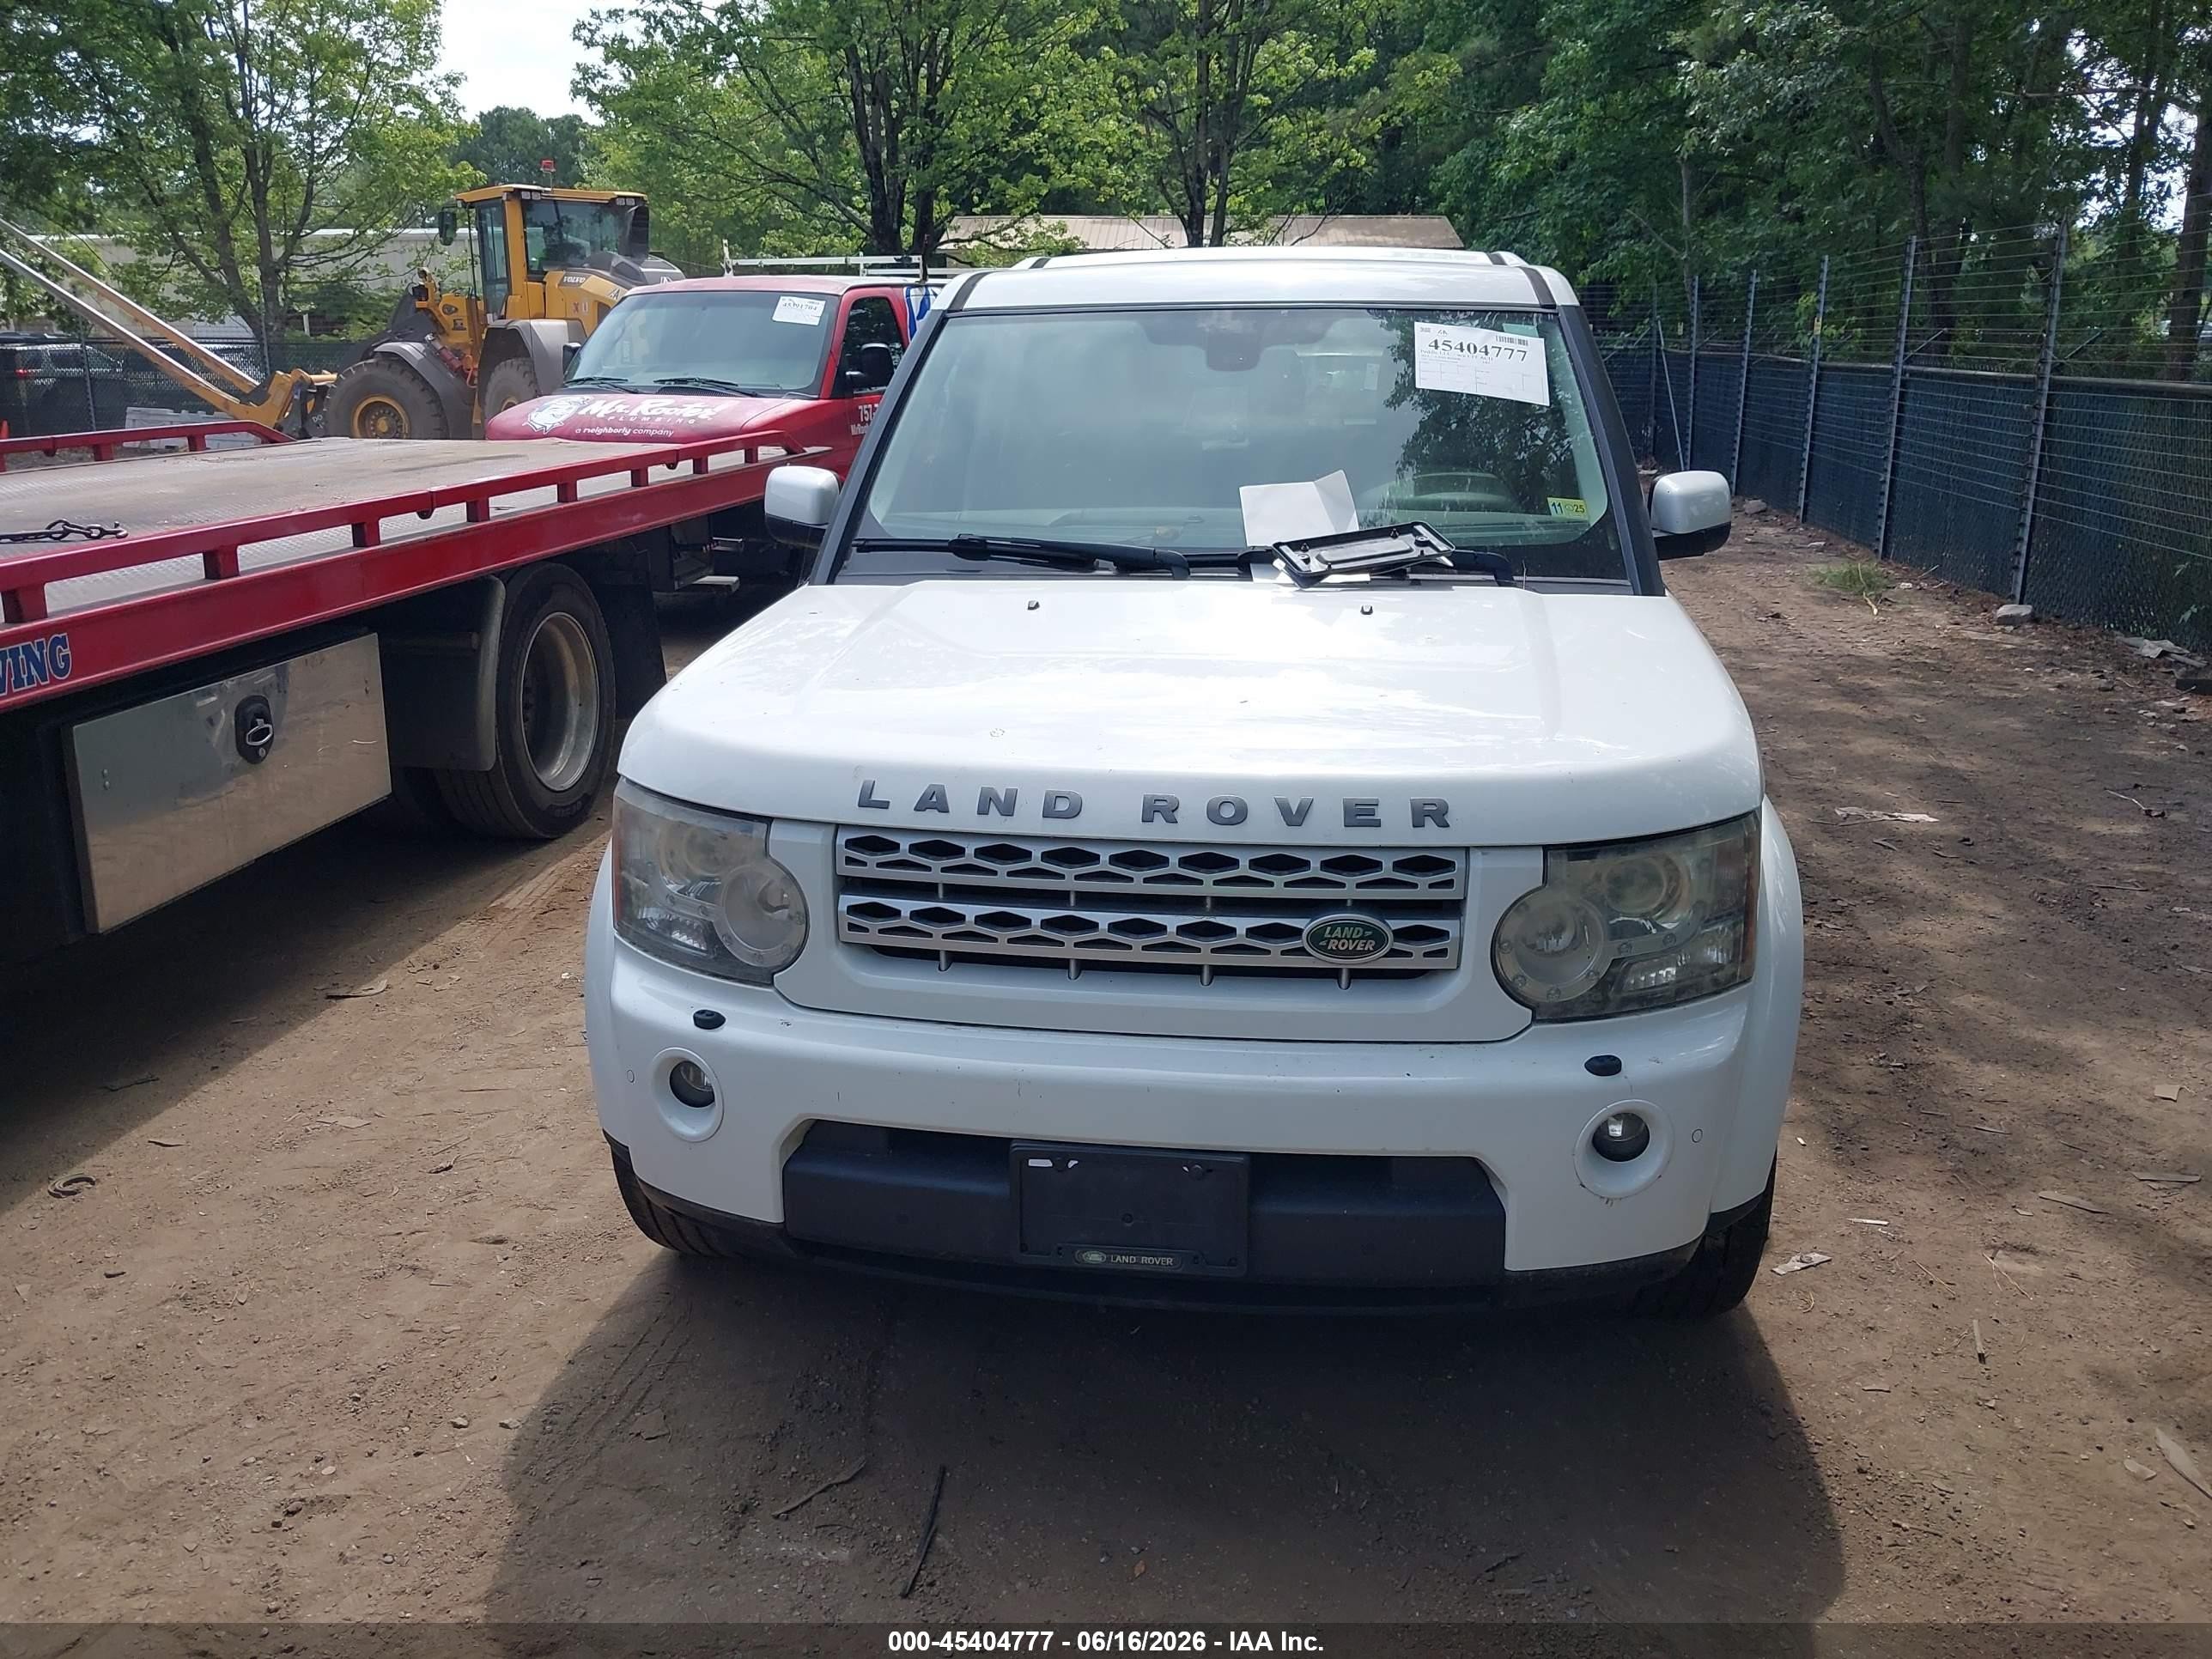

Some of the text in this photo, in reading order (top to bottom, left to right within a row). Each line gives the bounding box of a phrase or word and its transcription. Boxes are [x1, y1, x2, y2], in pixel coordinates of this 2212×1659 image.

[1428, 338, 1527, 362] 45404777
[578, 398, 630, 417] Mr.
[607, 416, 696, 425] PLUMBING
[583, 427, 631, 436] neighborly
[632, 428, 674, 437] company
[1551, 501, 1585, 514] 11 25
[857, 780, 1450, 829] LAND ROVER
[1323, 927, 1364, 939] LAND
[1327, 939, 1376, 951] ROVER
[1110, 1255, 1136, 1264] LAND
[1141, 1256, 1173, 1266] ROVER
